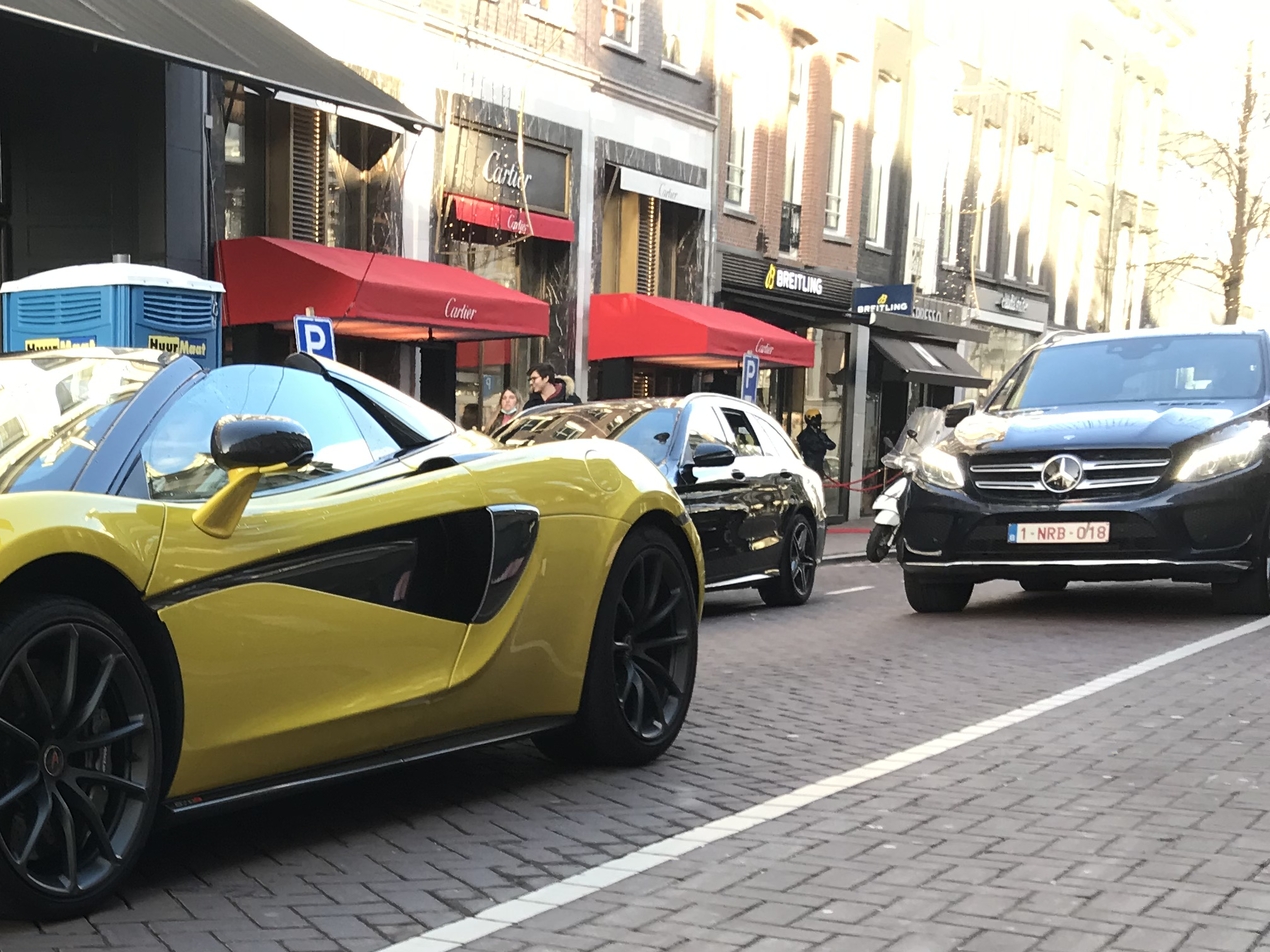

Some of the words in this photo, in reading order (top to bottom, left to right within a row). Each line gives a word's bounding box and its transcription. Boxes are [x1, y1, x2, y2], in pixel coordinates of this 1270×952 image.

[482, 150, 532, 189] Cartier
[776, 269, 823, 295] BREITLING
[445, 298, 477, 320] Cartier
[857, 302, 908, 314] BREITLING
[304, 324, 326, 354] P
[755, 337, 775, 355] Cartier
[745, 360, 756, 389] P
